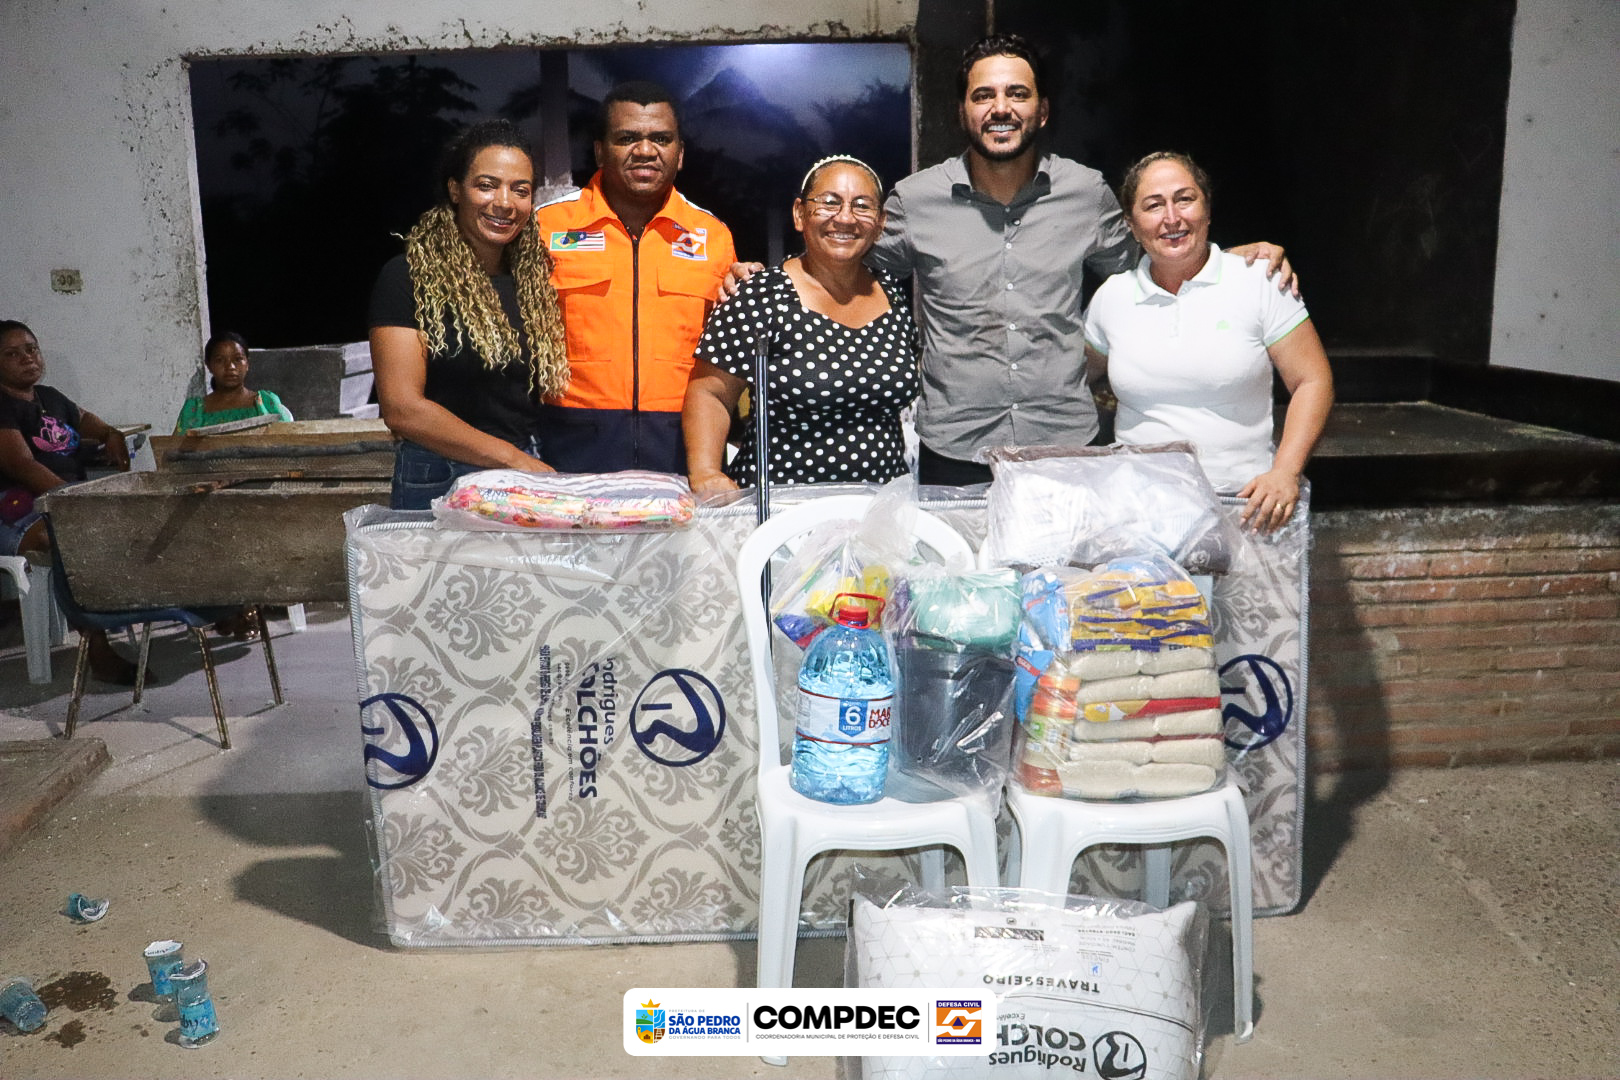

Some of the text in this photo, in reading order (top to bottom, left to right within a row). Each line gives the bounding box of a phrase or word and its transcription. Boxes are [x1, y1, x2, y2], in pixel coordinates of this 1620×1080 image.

[845, 706, 861, 725] 6
[983, 974, 1100, 993] TRAVESSEIRO
[996, 1023, 1087, 1051] COLCH
[988, 1045, 1087, 1073] Rodrigues
